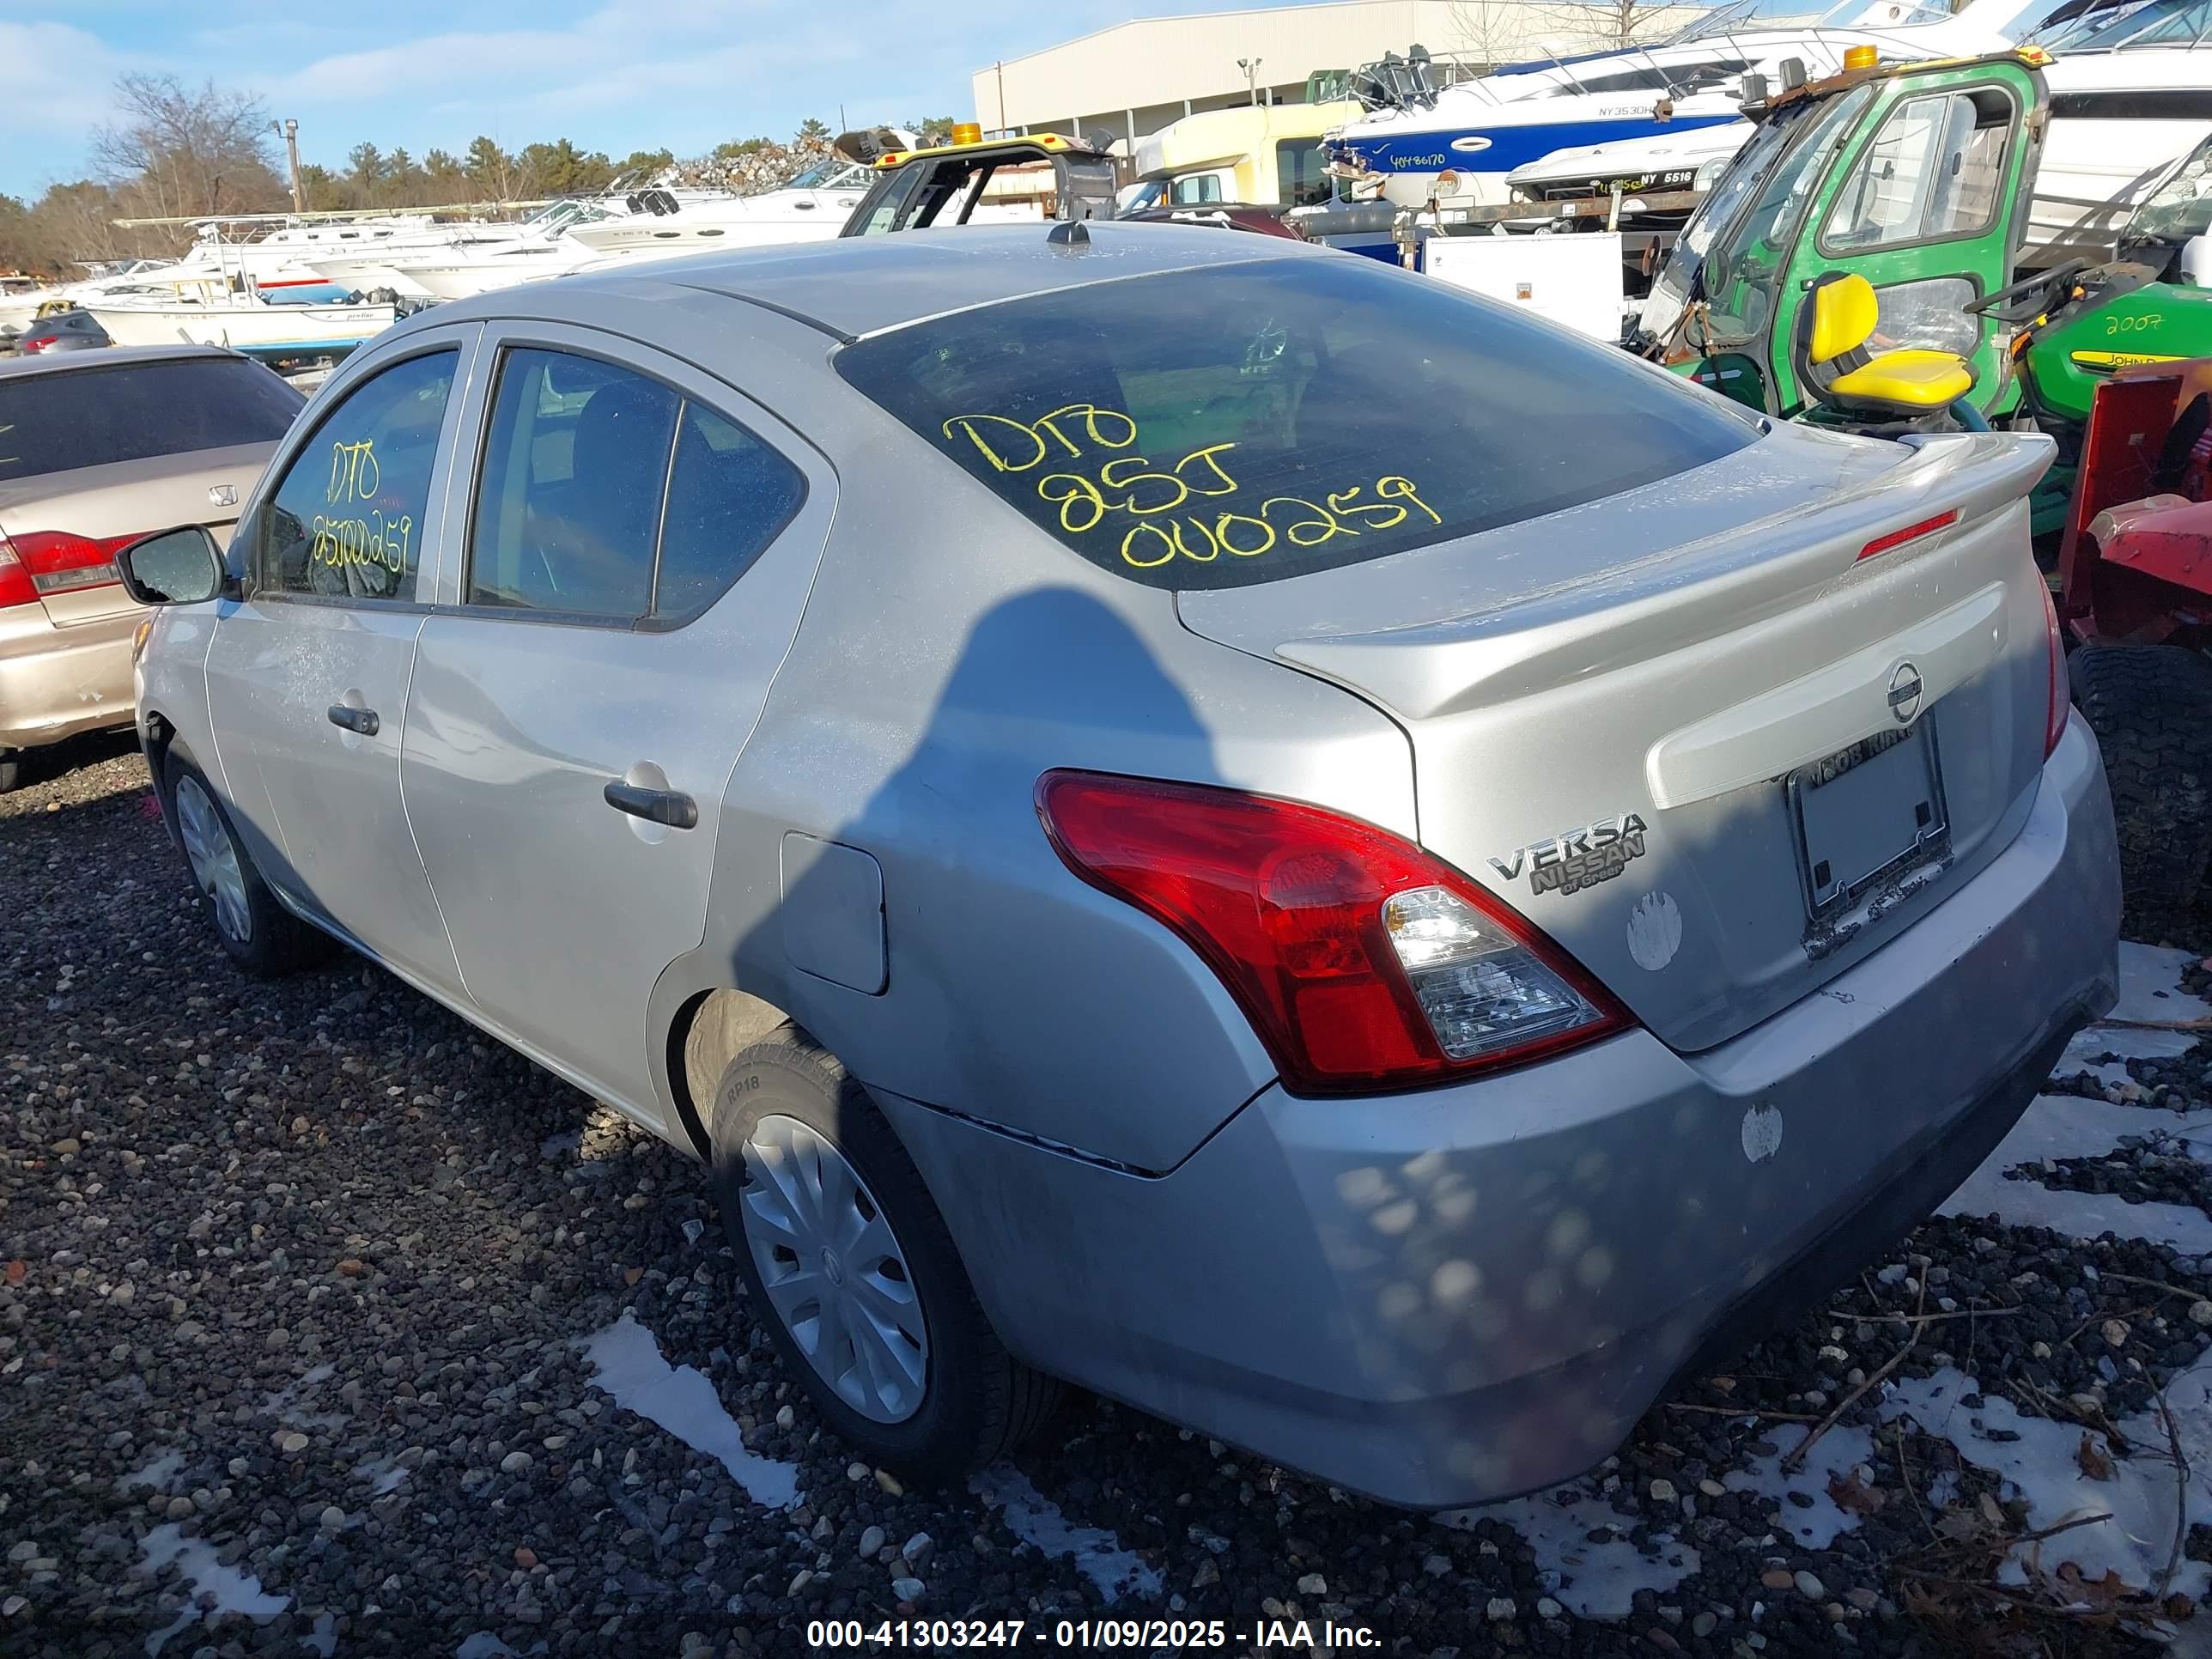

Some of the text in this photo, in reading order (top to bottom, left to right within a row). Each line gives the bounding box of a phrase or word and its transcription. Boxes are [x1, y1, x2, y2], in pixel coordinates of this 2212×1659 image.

[1641, 172, 1692, 185] NY 5516
[2106, 314, 2165, 335] 2007
[1486, 811, 1648, 883] VERSA
[1530, 833, 1645, 895] NISSAN
[1562, 879, 1580, 896] of
[727, 1075, 760, 1106] RP18
